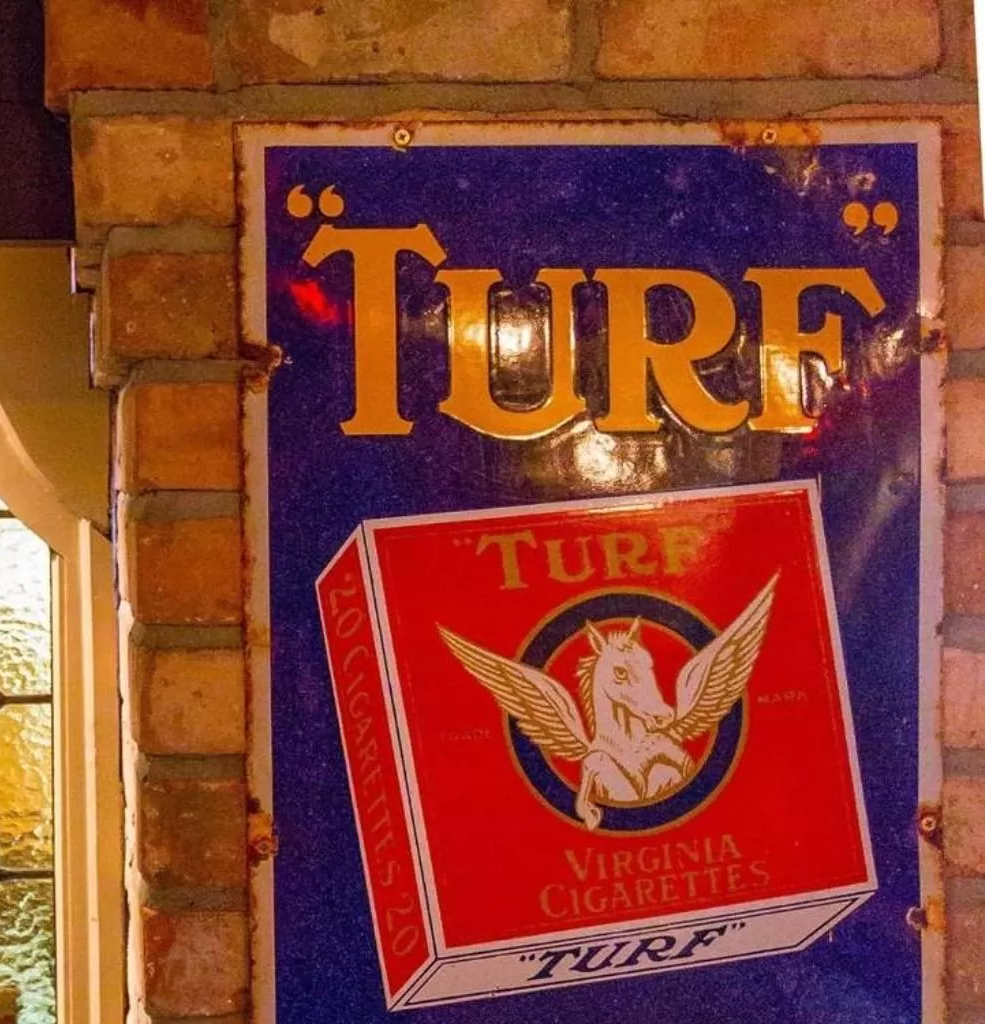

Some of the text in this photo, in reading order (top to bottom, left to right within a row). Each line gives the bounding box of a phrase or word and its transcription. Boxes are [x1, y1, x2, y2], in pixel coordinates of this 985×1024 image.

[286, 183, 899, 441] “TURF”
[342, 645, 401, 887] CIGARETTES
[538, 859, 772, 918] CIGARETTES
[564, 833, 743, 881] VIRGINIA
